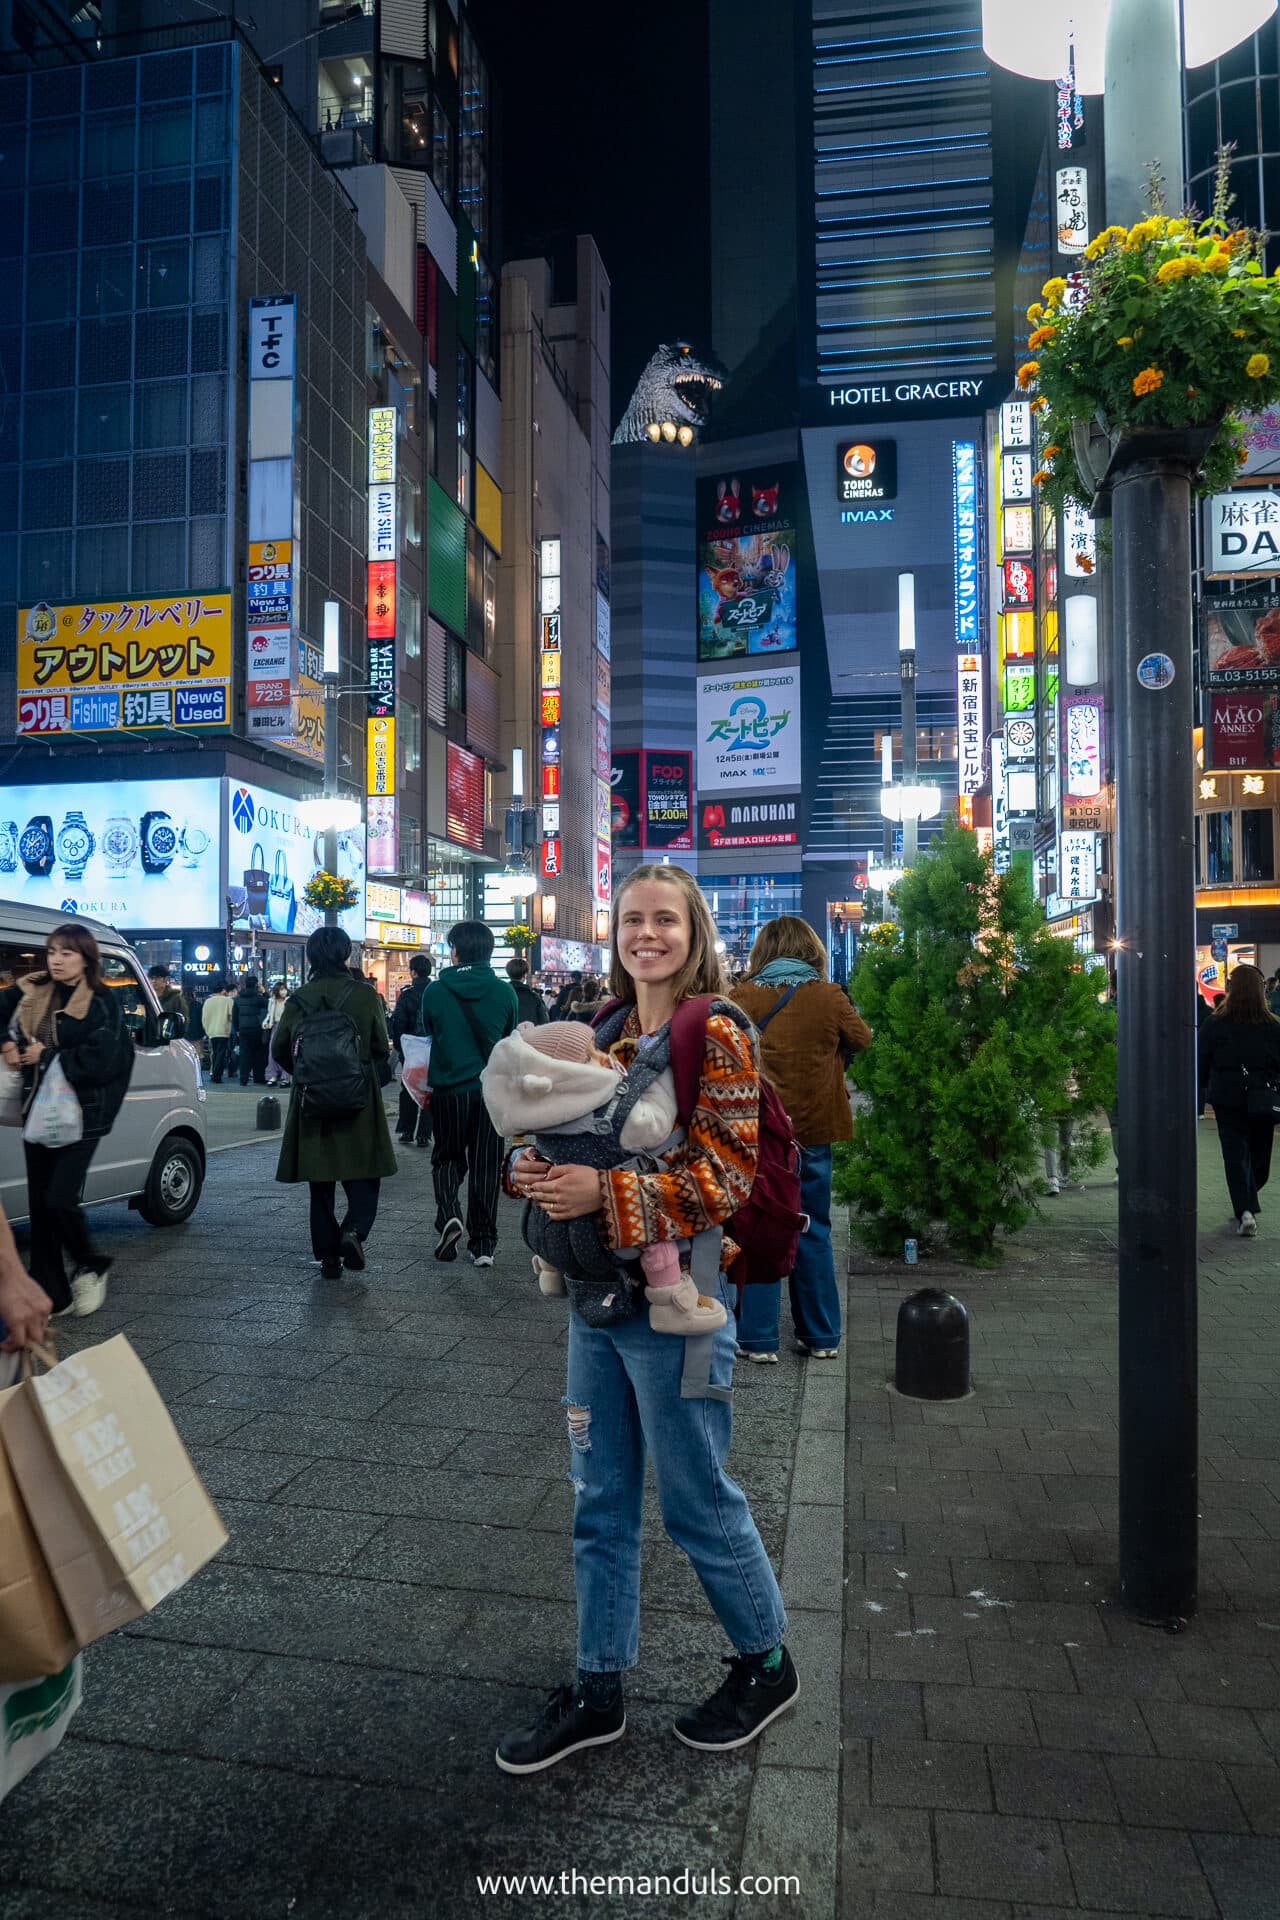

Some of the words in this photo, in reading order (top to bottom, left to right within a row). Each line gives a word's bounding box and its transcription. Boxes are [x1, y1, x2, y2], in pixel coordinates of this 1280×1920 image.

[831, 387, 891, 406] HOTEL
[895, 380, 983, 401] GRACERY
[844, 480, 872, 490] TOHO
[844, 489, 884, 499] CINEMAS
[841, 510, 893, 523] IMAX
[1220, 500, 1280, 527] 麻雀
[378, 492, 391, 551] CAPSULE
[250, 564, 290, 580] つり具
[253, 582, 287, 596] 釣具
[250, 599, 274, 607] New
[260, 604, 289, 612] Used
[76, 599, 223, 635] タックルベリー
[33, 637, 215, 685] アウトレット
[371, 647, 379, 662] BAR
[254, 657, 286, 666] EXCHANGE
[371, 671, 379, 686] PUB
[379, 645, 393, 705] AGEHA
[256, 690, 284, 702] 729
[20, 697, 67, 730] つり具
[73, 698, 118, 726] Fishing
[124, 691, 172, 725] 釣具
[176, 691, 224, 705] New&
[181, 706, 222, 721] Used
[376, 707, 387, 715] 2F
[706, 709, 791, 742] ズートピア
[1220, 724, 1256, 733] ANNEX
[962, 678, 978, 794] 新宿東宝ビル店
[1229, 757, 1248, 766] B1F
[652, 766, 684, 779] FOD
[720, 769, 748, 778] IMAX
[731, 803, 796, 823] MARUHAN
[1069, 807, 1101, 817] 第103
[258, 806, 311, 839] OKURA
[1069, 818, 1101, 829] 東京ビル
[80, 902, 127, 912] OKURA
[184, 963, 220, 971] OKURA
